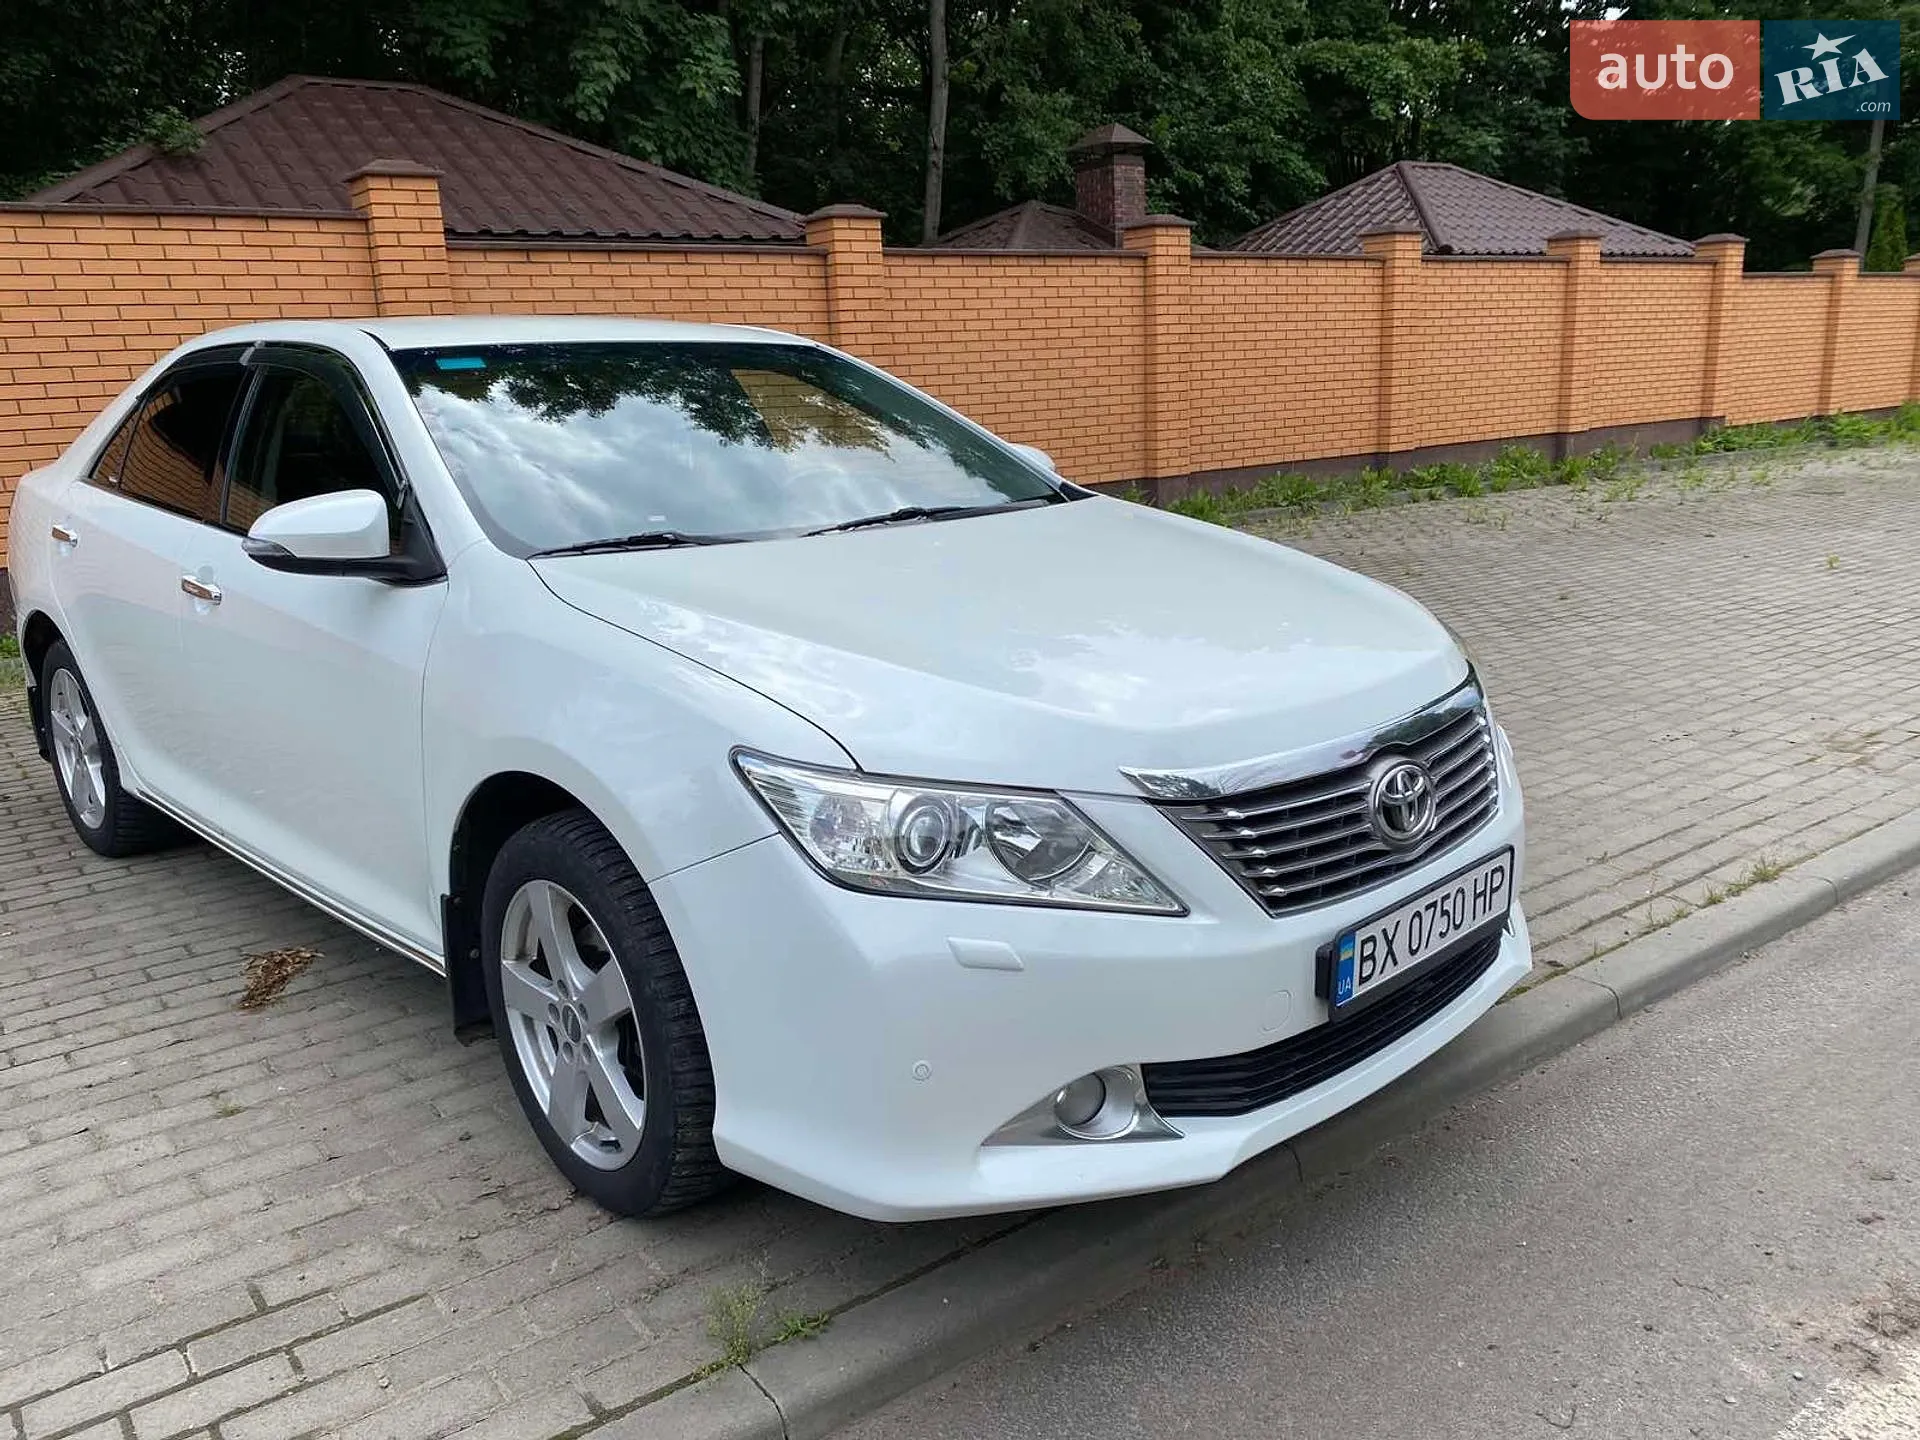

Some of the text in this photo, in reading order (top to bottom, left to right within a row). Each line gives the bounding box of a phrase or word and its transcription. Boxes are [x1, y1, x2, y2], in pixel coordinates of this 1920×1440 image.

[1359, 865, 1505, 986] BX 0750 HP
[1338, 978, 1352, 995] UA
